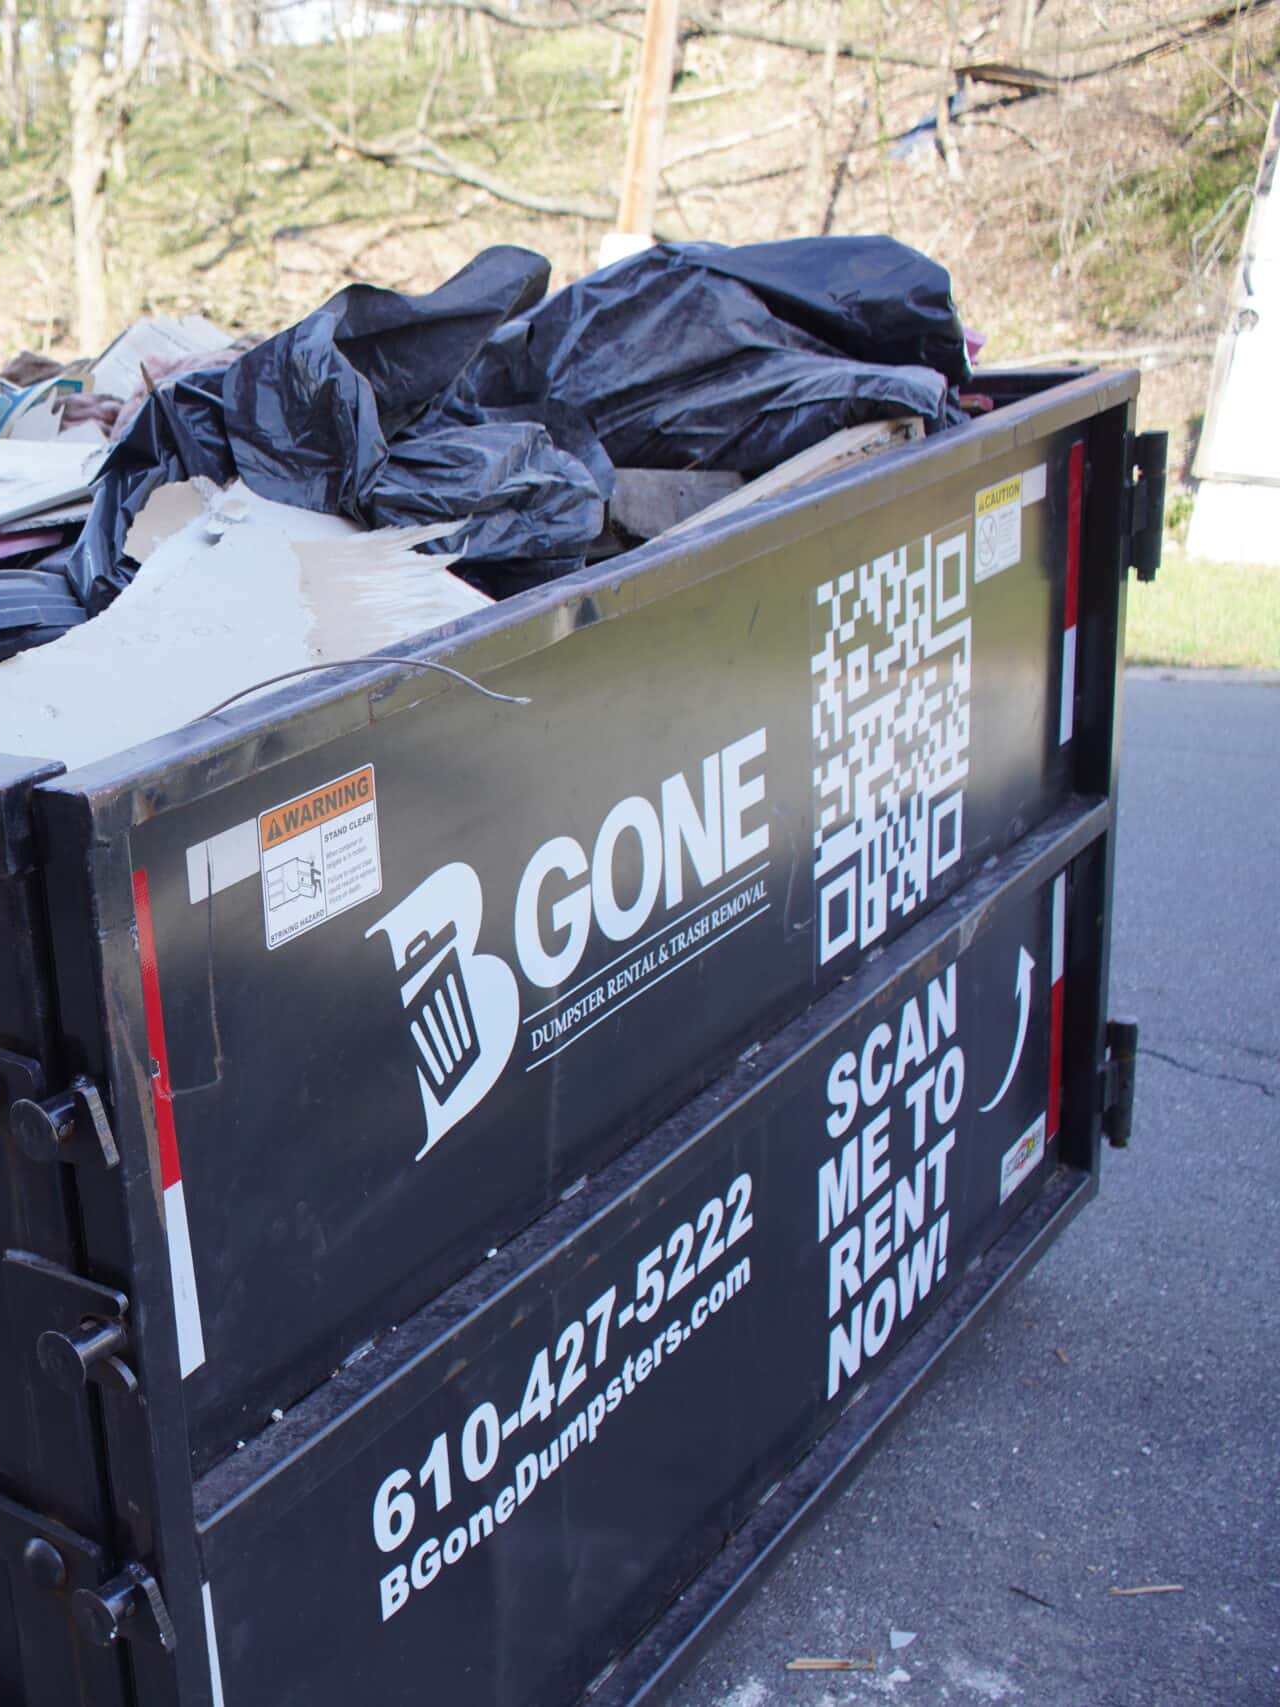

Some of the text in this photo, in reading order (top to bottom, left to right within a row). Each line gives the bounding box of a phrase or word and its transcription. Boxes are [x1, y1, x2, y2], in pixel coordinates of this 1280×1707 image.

[984, 482, 1020, 509] CAUTION
[282, 776, 370, 833] WARNING
[324, 825, 348, 842] STAND
[515, 727, 770, 989] GONE
[271, 909, 324, 942] STRIKING HAZARD
[531, 880, 767, 1051] DUMPSTER RENTAL & TRASH REMOVAL
[826, 962, 957, 1138] SCAN
[818, 1106, 891, 1243] ME
[906, 1046, 965, 1152] TO
[829, 1128, 956, 1319] RENT
[372, 1173, 754, 1553] 610-427-5222
[827, 1210, 950, 1401] NOW!
[380, 1256, 751, 1622] BGoneDumpsters.com
